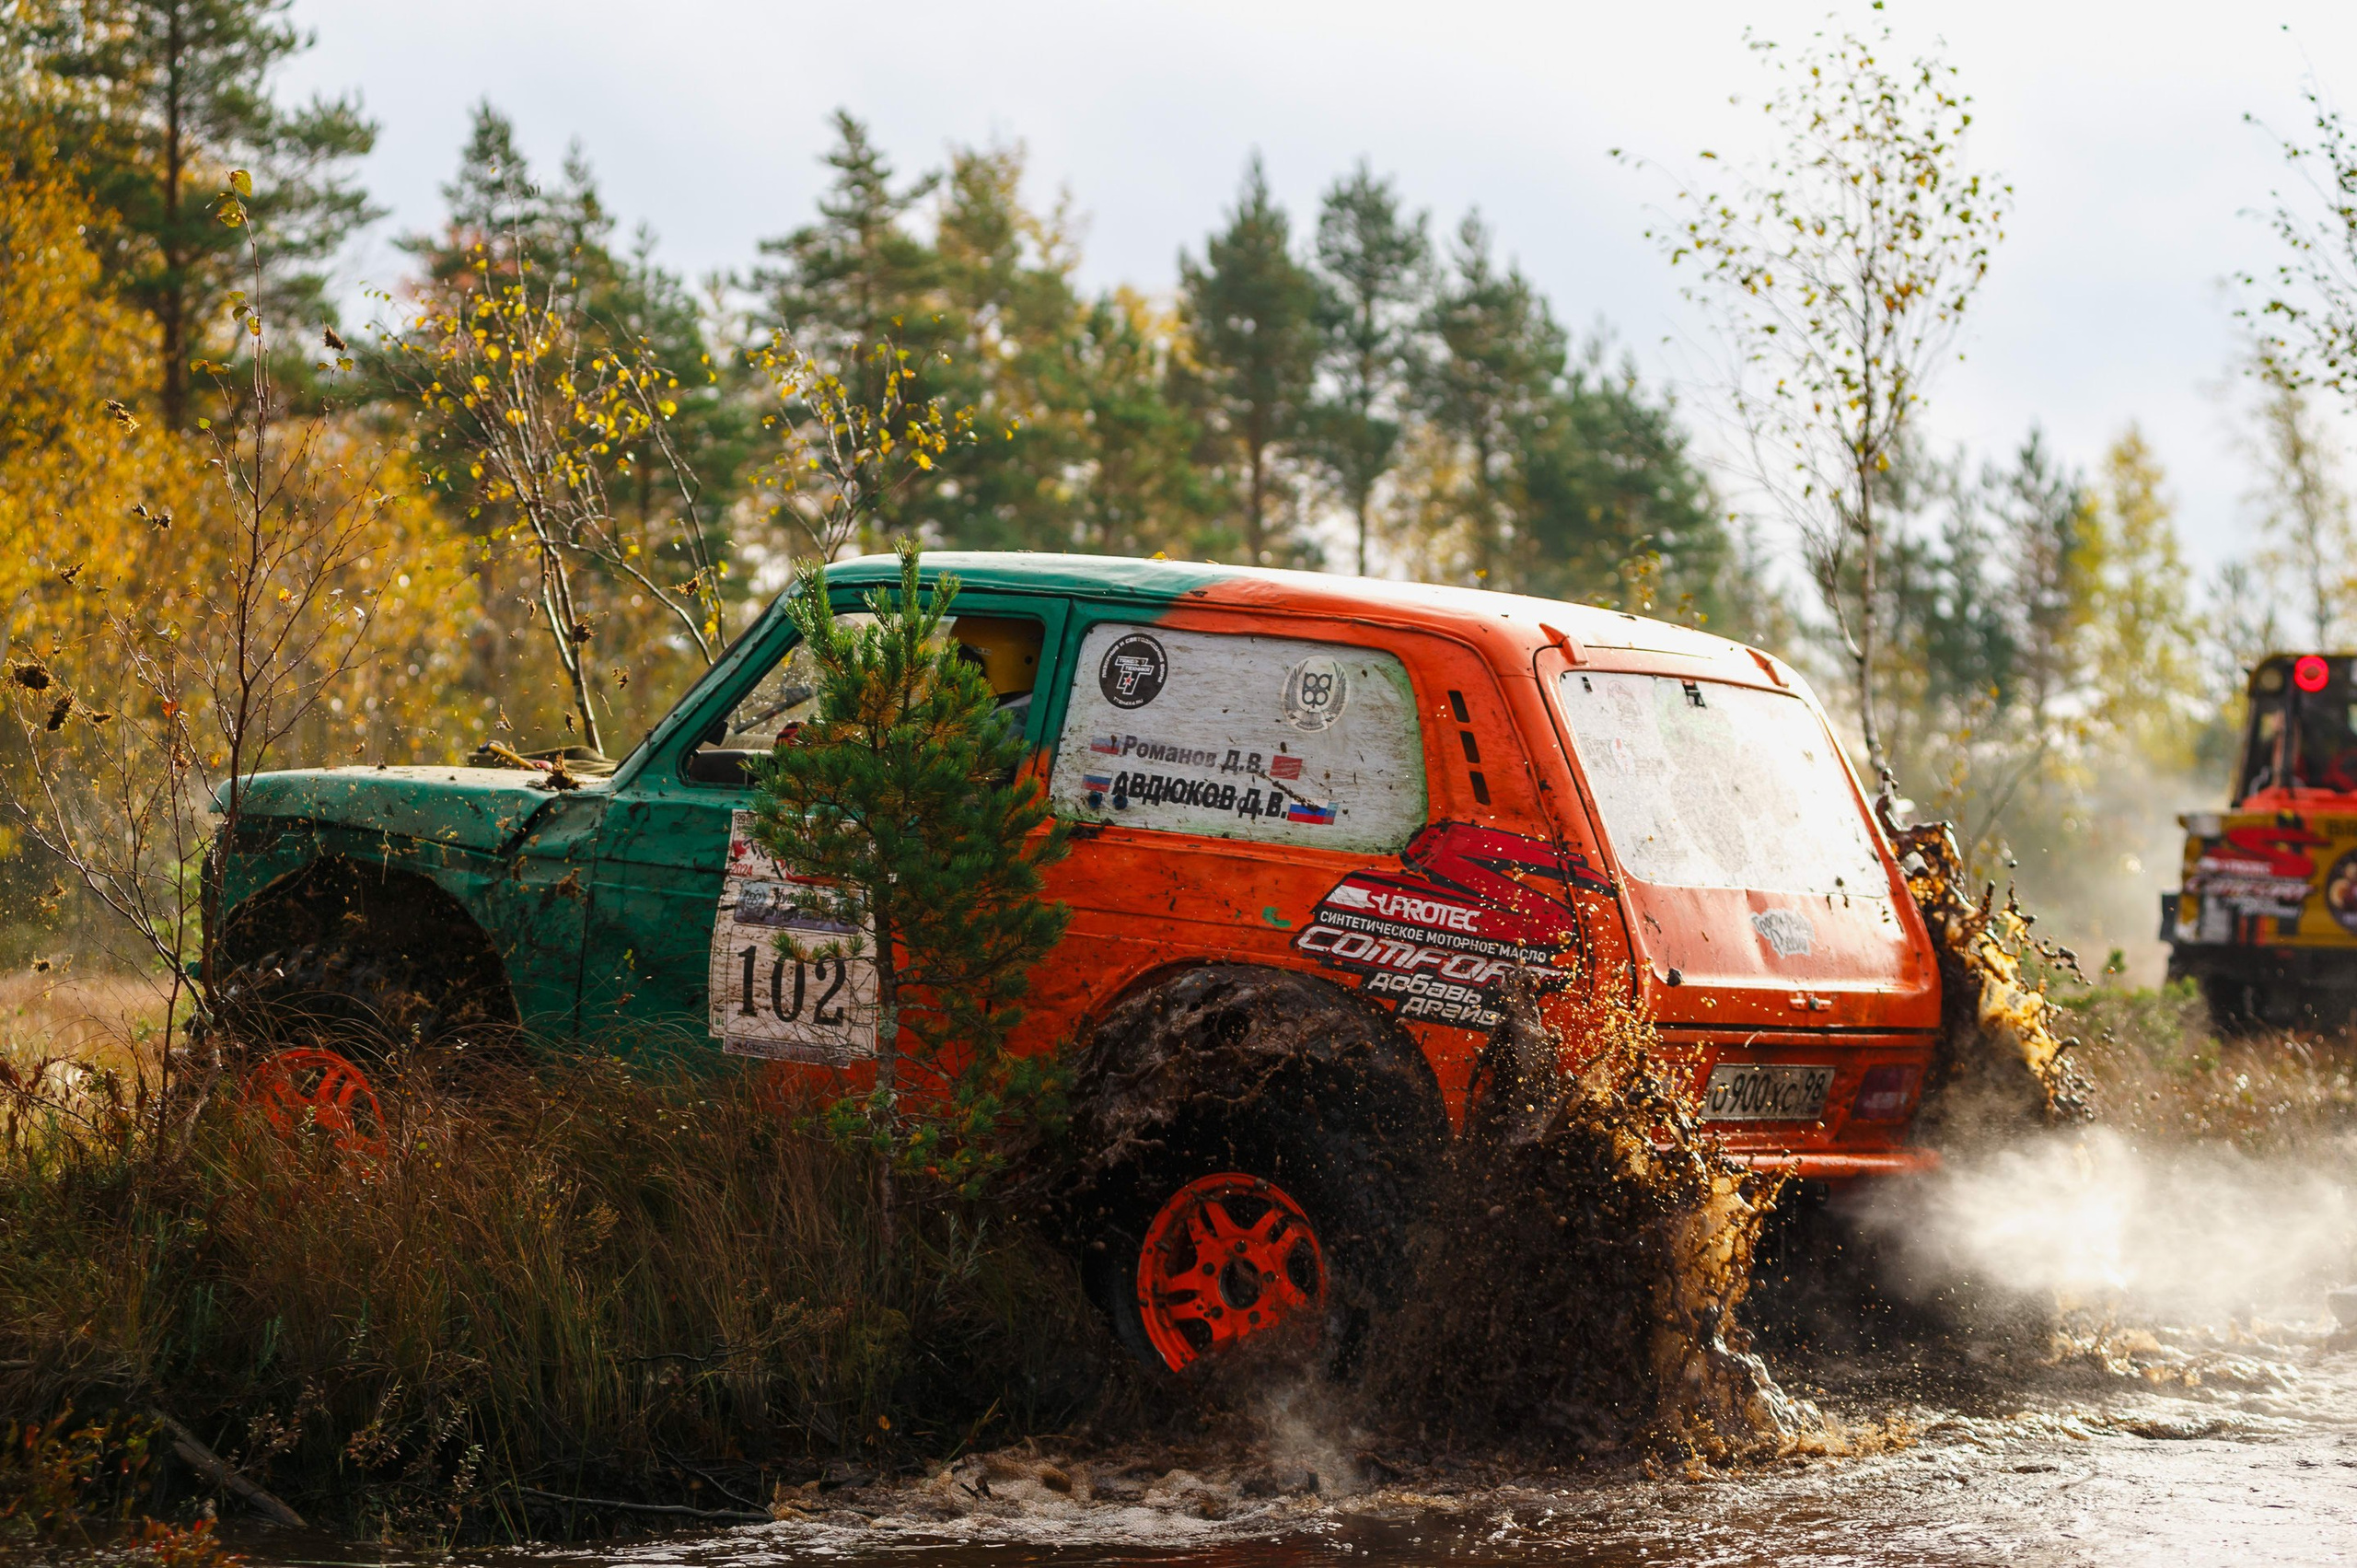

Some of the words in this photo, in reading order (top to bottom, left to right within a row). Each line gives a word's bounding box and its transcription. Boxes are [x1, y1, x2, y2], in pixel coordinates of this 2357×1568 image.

[1121, 735, 1217, 768] Романов
[1111, 771, 1237, 811] АВДЮКОВ
[1238, 787, 1288, 819] Д.В.
[731, 863, 753, 876] 2024
[1319, 910, 1423, 941] СИНТЕТИЧЕСКОЕ
[1426, 931, 1497, 956] МОТОРНОЕ
[1499, 943, 1547, 963] МАСЛО
[737, 945, 845, 1027] 102
